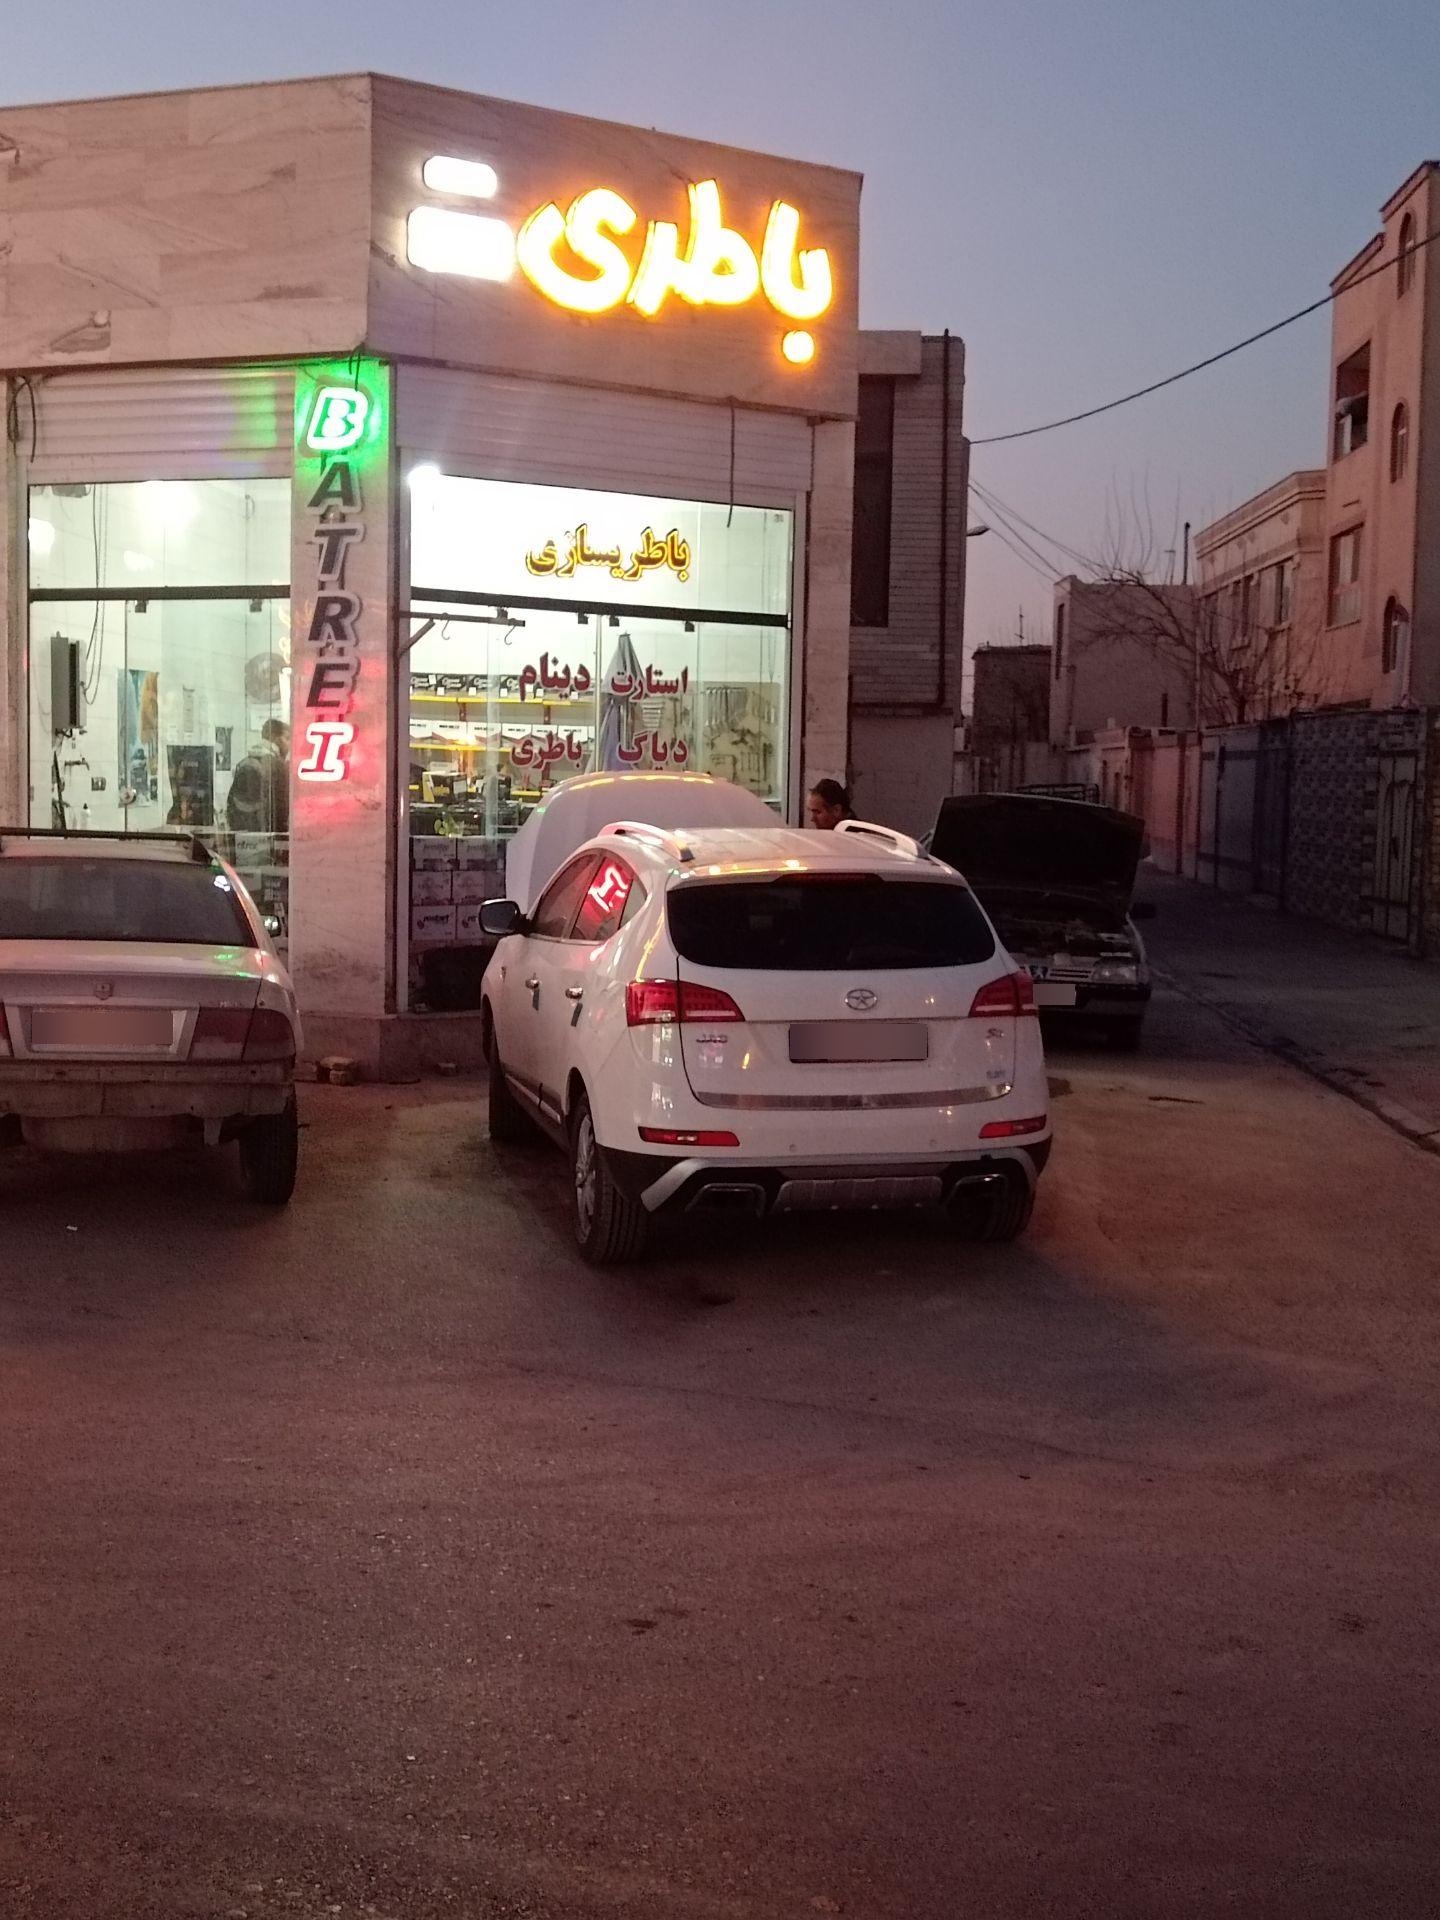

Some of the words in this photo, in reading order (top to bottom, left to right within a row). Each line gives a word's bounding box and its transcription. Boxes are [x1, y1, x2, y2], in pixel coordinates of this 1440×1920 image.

[516, 178, 832, 364] باطری
[298, 386, 370, 782] BATREI
[519, 652, 591, 701] دینام
[611, 663, 688, 702] استارت
[511, 730, 583, 769] باطری
